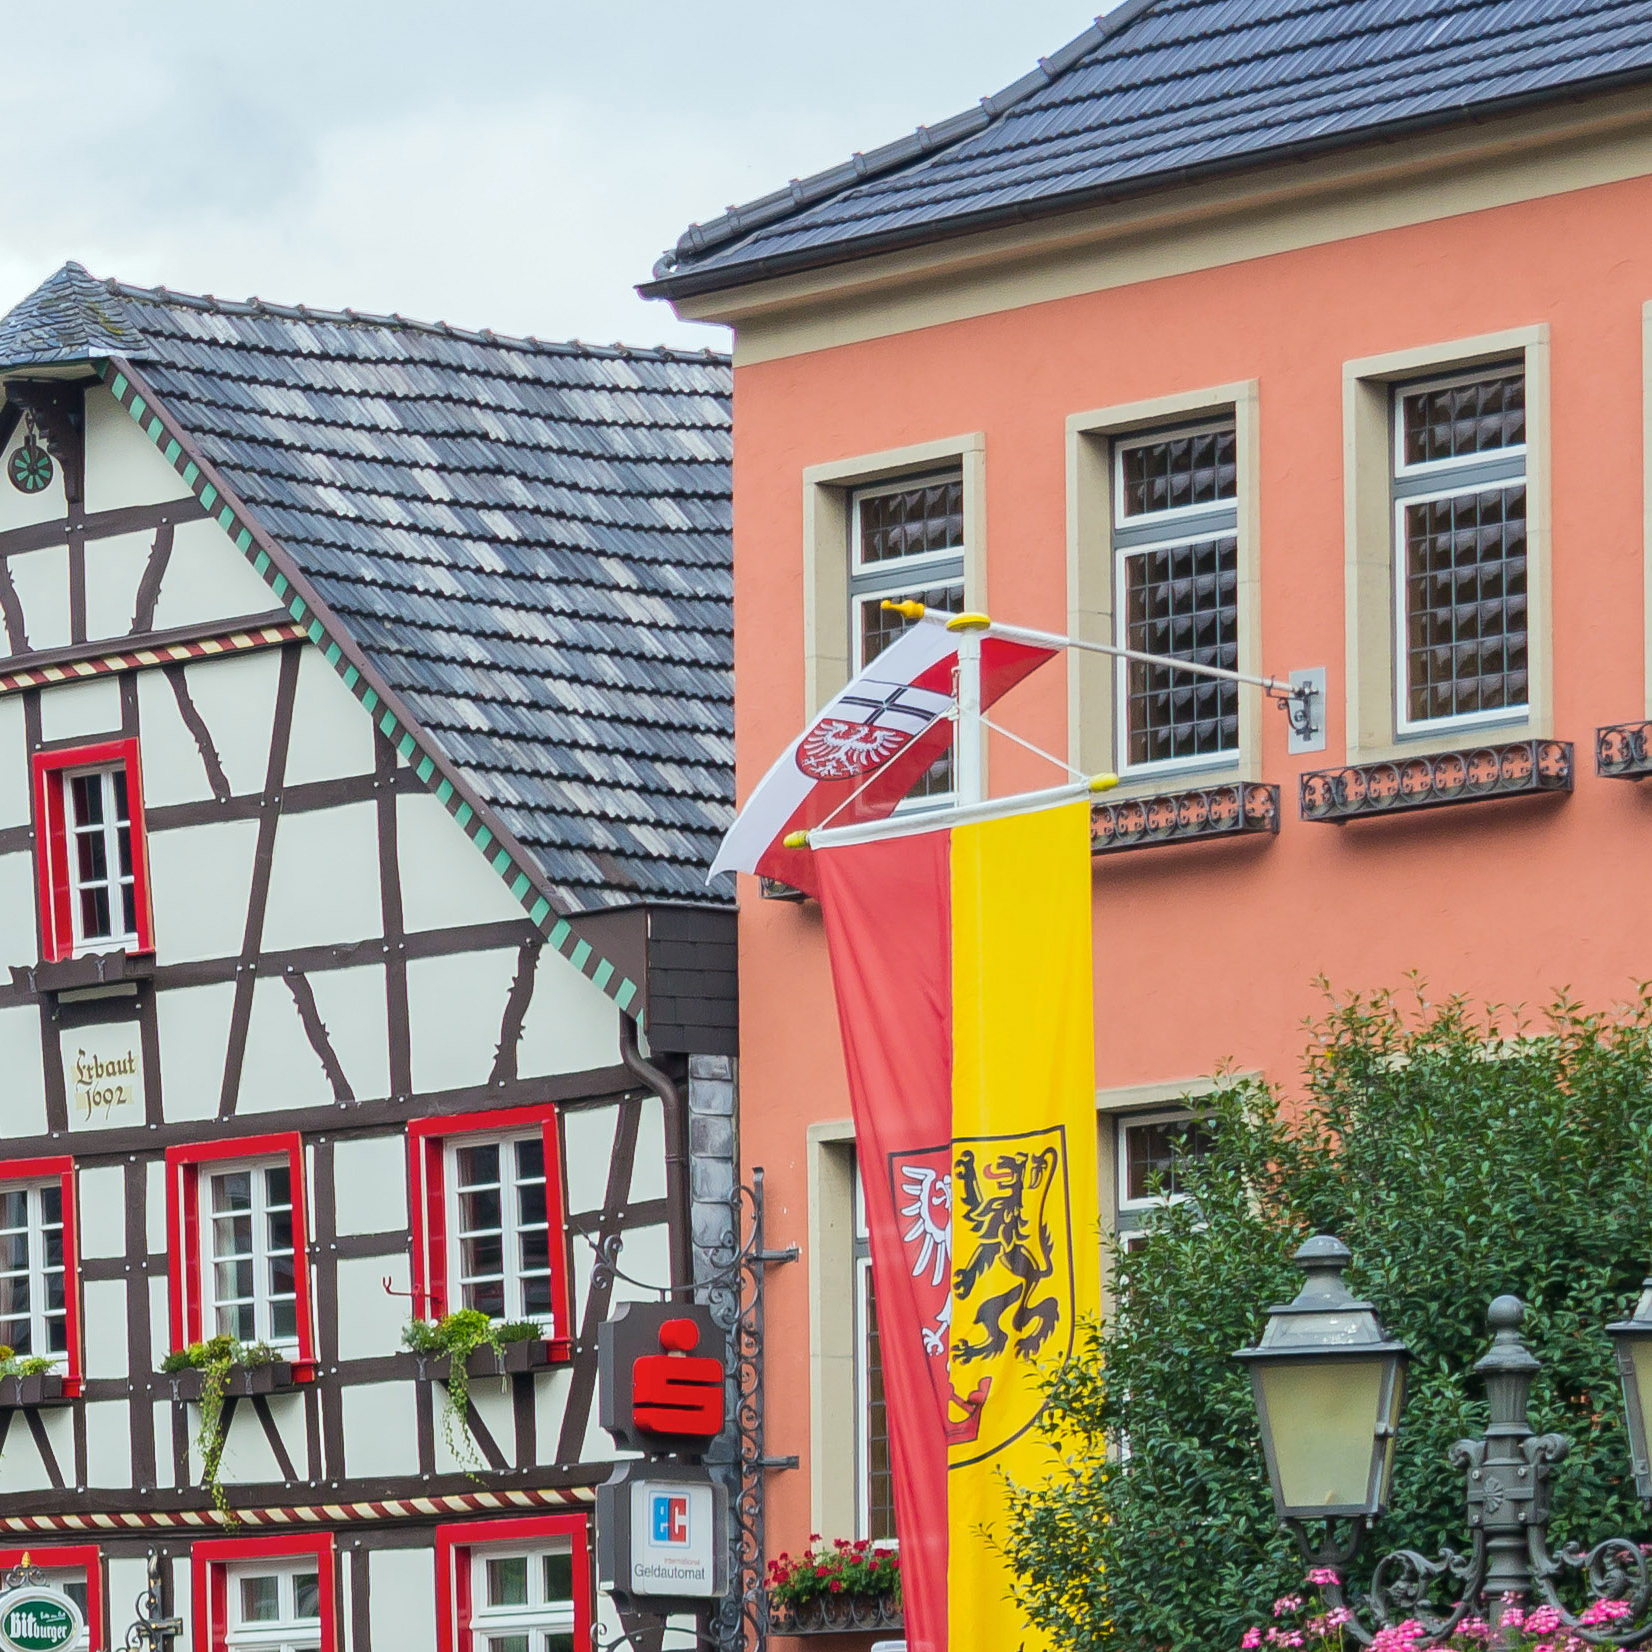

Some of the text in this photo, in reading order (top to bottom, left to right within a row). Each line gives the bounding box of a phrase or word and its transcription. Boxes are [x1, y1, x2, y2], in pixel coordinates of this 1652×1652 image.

[76, 1048, 136, 1091] Erbaut
[85, 1081, 127, 1122] 1692
[634, 1563, 705, 1580] Geldautomat
[9, 1611, 68, 1644] Bitburger
